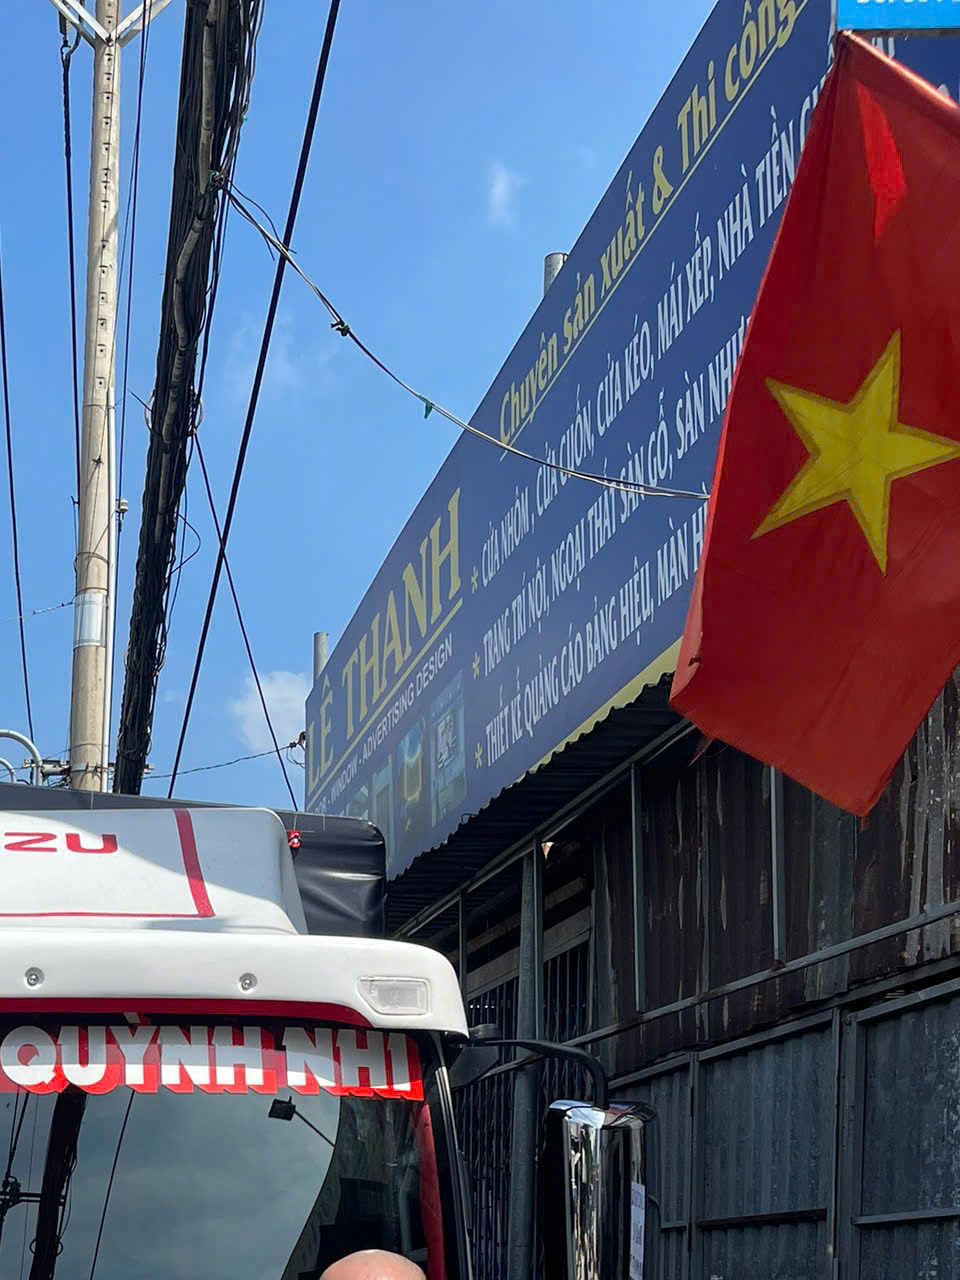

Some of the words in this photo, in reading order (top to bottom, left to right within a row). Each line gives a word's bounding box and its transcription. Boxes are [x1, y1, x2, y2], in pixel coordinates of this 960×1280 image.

[500, 332, 558, 446] Chuyên
[563, 272, 596, 354] sản
[600, 169, 646, 299] xuất
[652, 145, 674, 216] &
[677, 60, 717, 174] Thi
[725, 0, 798, 102] công
[536, 441, 559, 517] CỬA
[596, 353, 623, 437] CỬA
[624, 313, 654, 403] KÉO,
[657, 261, 683, 360] MÁI
[686, 211, 714, 322] XẾP,
[717, 163, 754, 280] NHÀ
[755, 105, 796, 229] TIỀN
[308, 673, 333, 796] LÊ
[342, 487, 461, 740] THANH
[483, 612, 511, 677] TRANG
[511, 572, 527, 645] TRÍ
[551, 518, 585, 602] NGOẠI
[587, 457, 616, 560] THẤT
[676, 370, 706, 459] SÀN
[486, 685, 509, 767] THIẾT
[523, 654, 560, 738] QUẢNG
[560, 623, 584, 697] CÁO
[586, 596, 618, 674] BẢNG
[620, 556, 654, 646] HIỆU,
[657, 517, 688, 606] MÀN
[330, 754, 358, 804] WINDOW
[362, 682, 415, 767] ADVERTISING
[416, 633, 453, 697] DESIGN
[0, 1012, 266, 1090] QUỲNH
[283, 1026, 414, 1093] NHI
